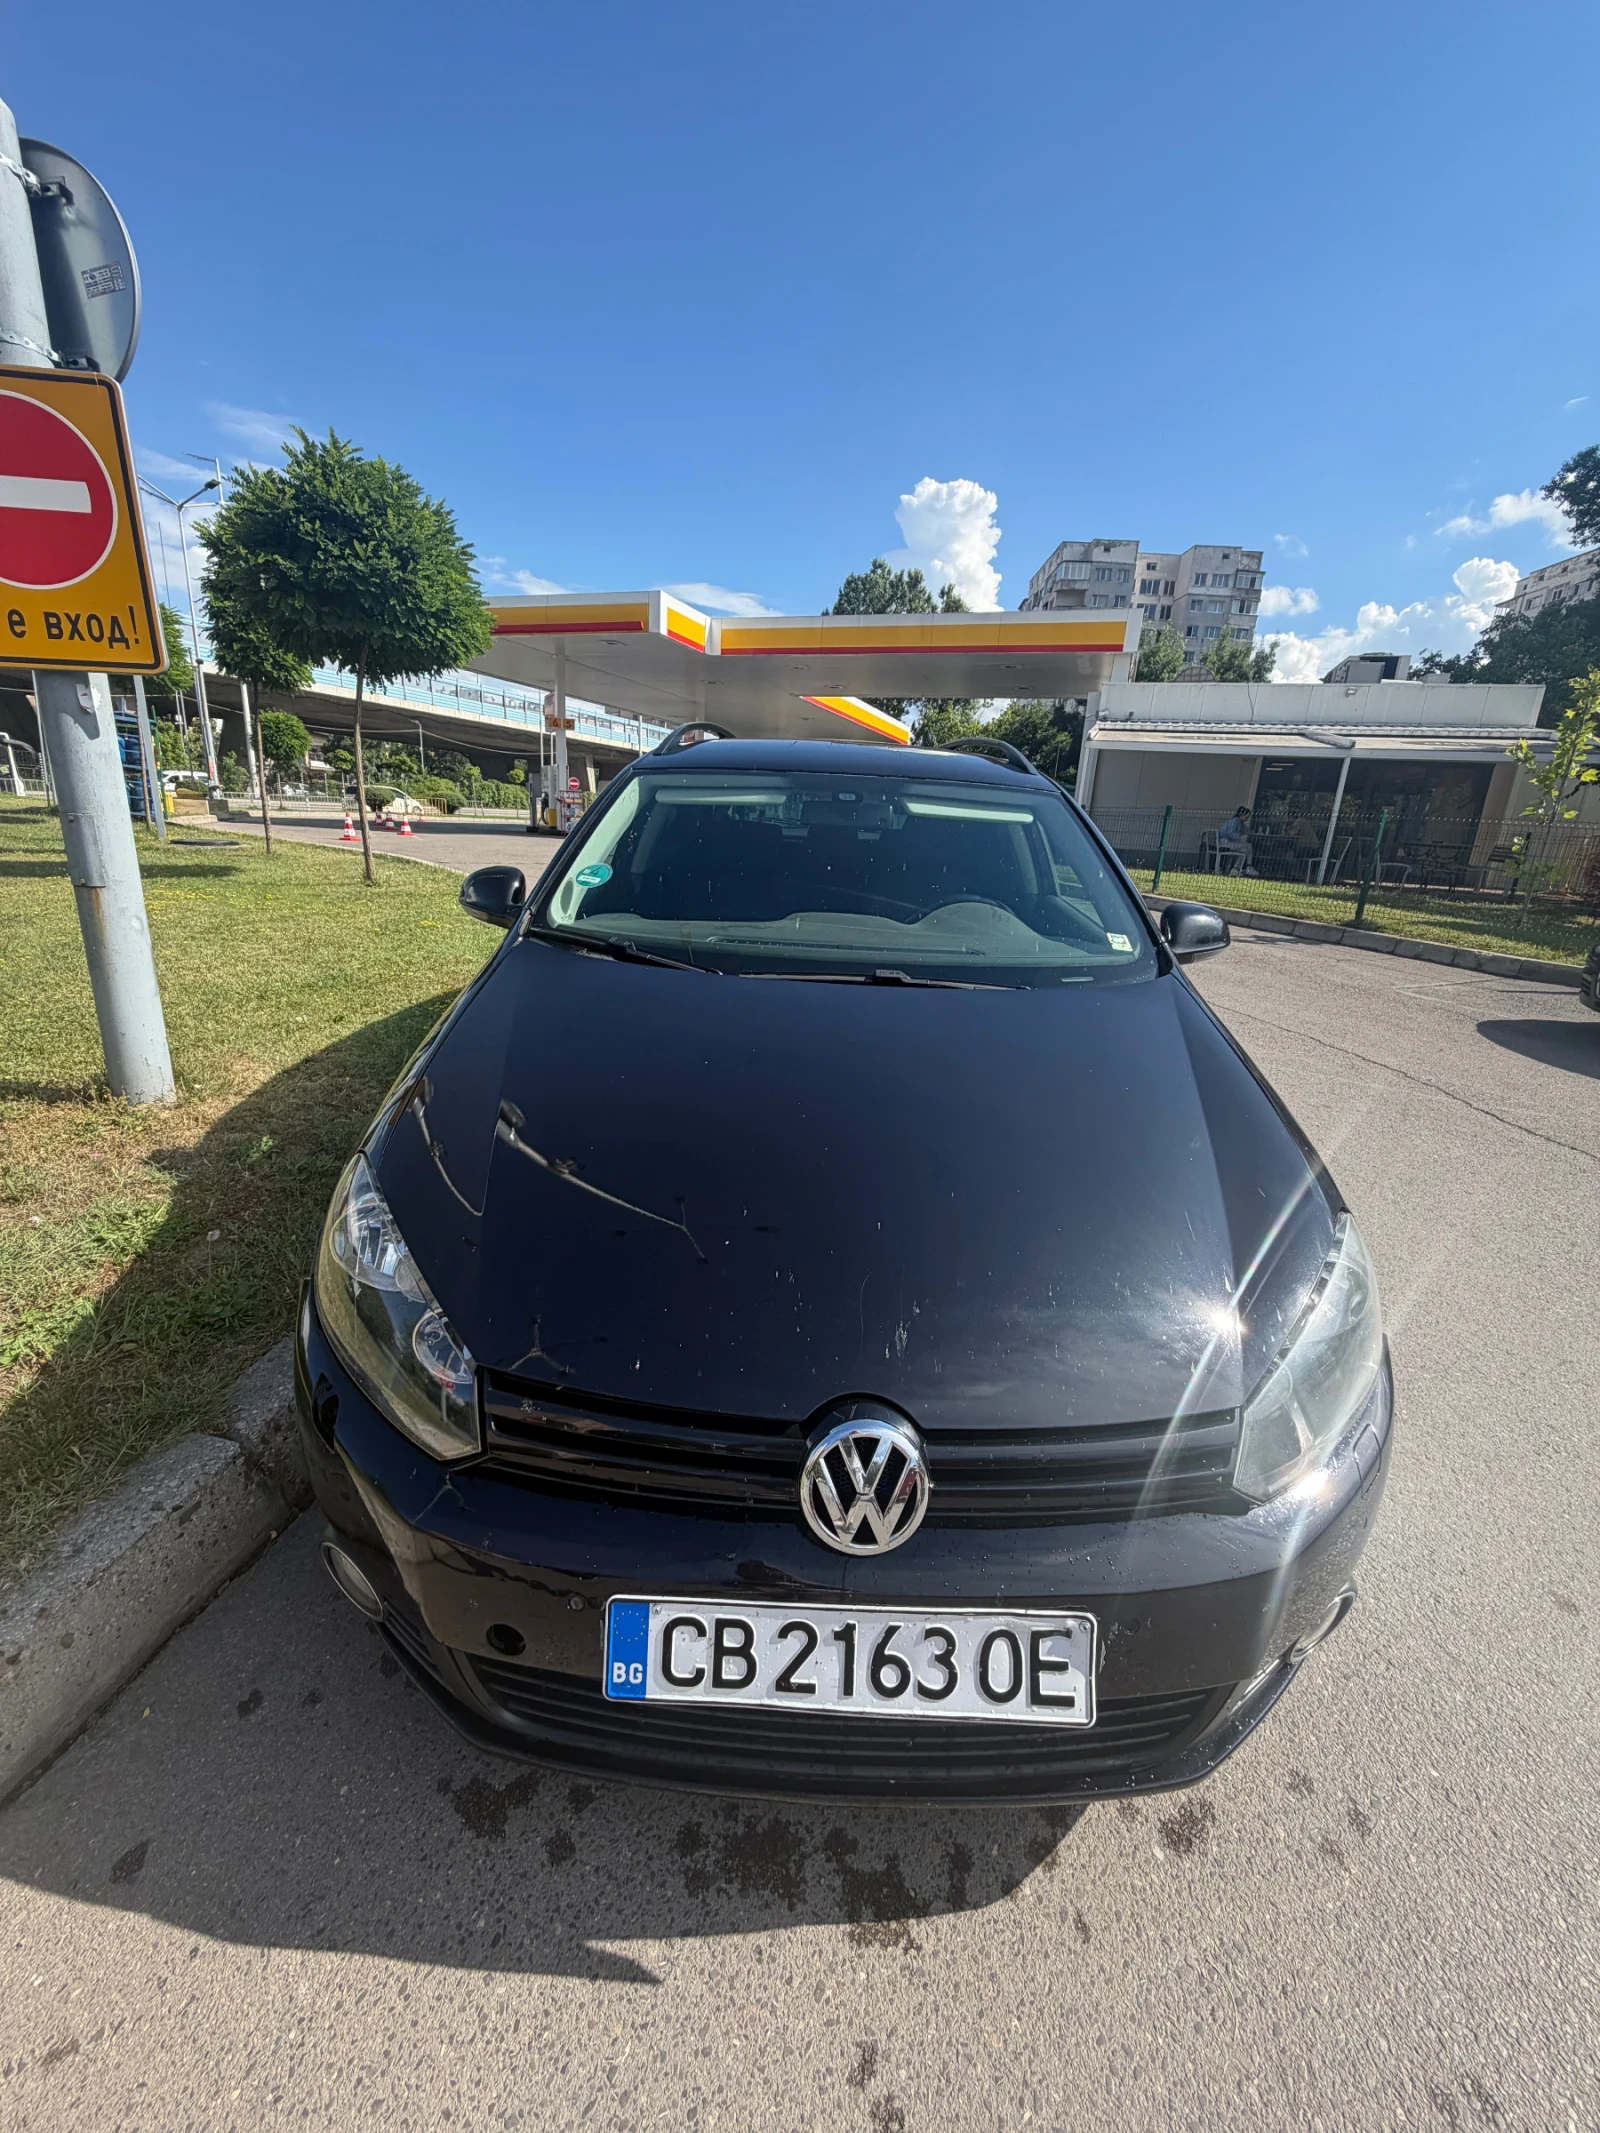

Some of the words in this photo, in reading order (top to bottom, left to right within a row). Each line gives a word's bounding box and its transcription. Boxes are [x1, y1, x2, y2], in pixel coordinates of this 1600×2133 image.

[7, 608, 27, 638] е
[43, 606, 139, 649] вход!
[806, 1425, 923, 1552] VW
[612, 1662, 643, 1684] BG
[774, 1620, 959, 1701] 2163
